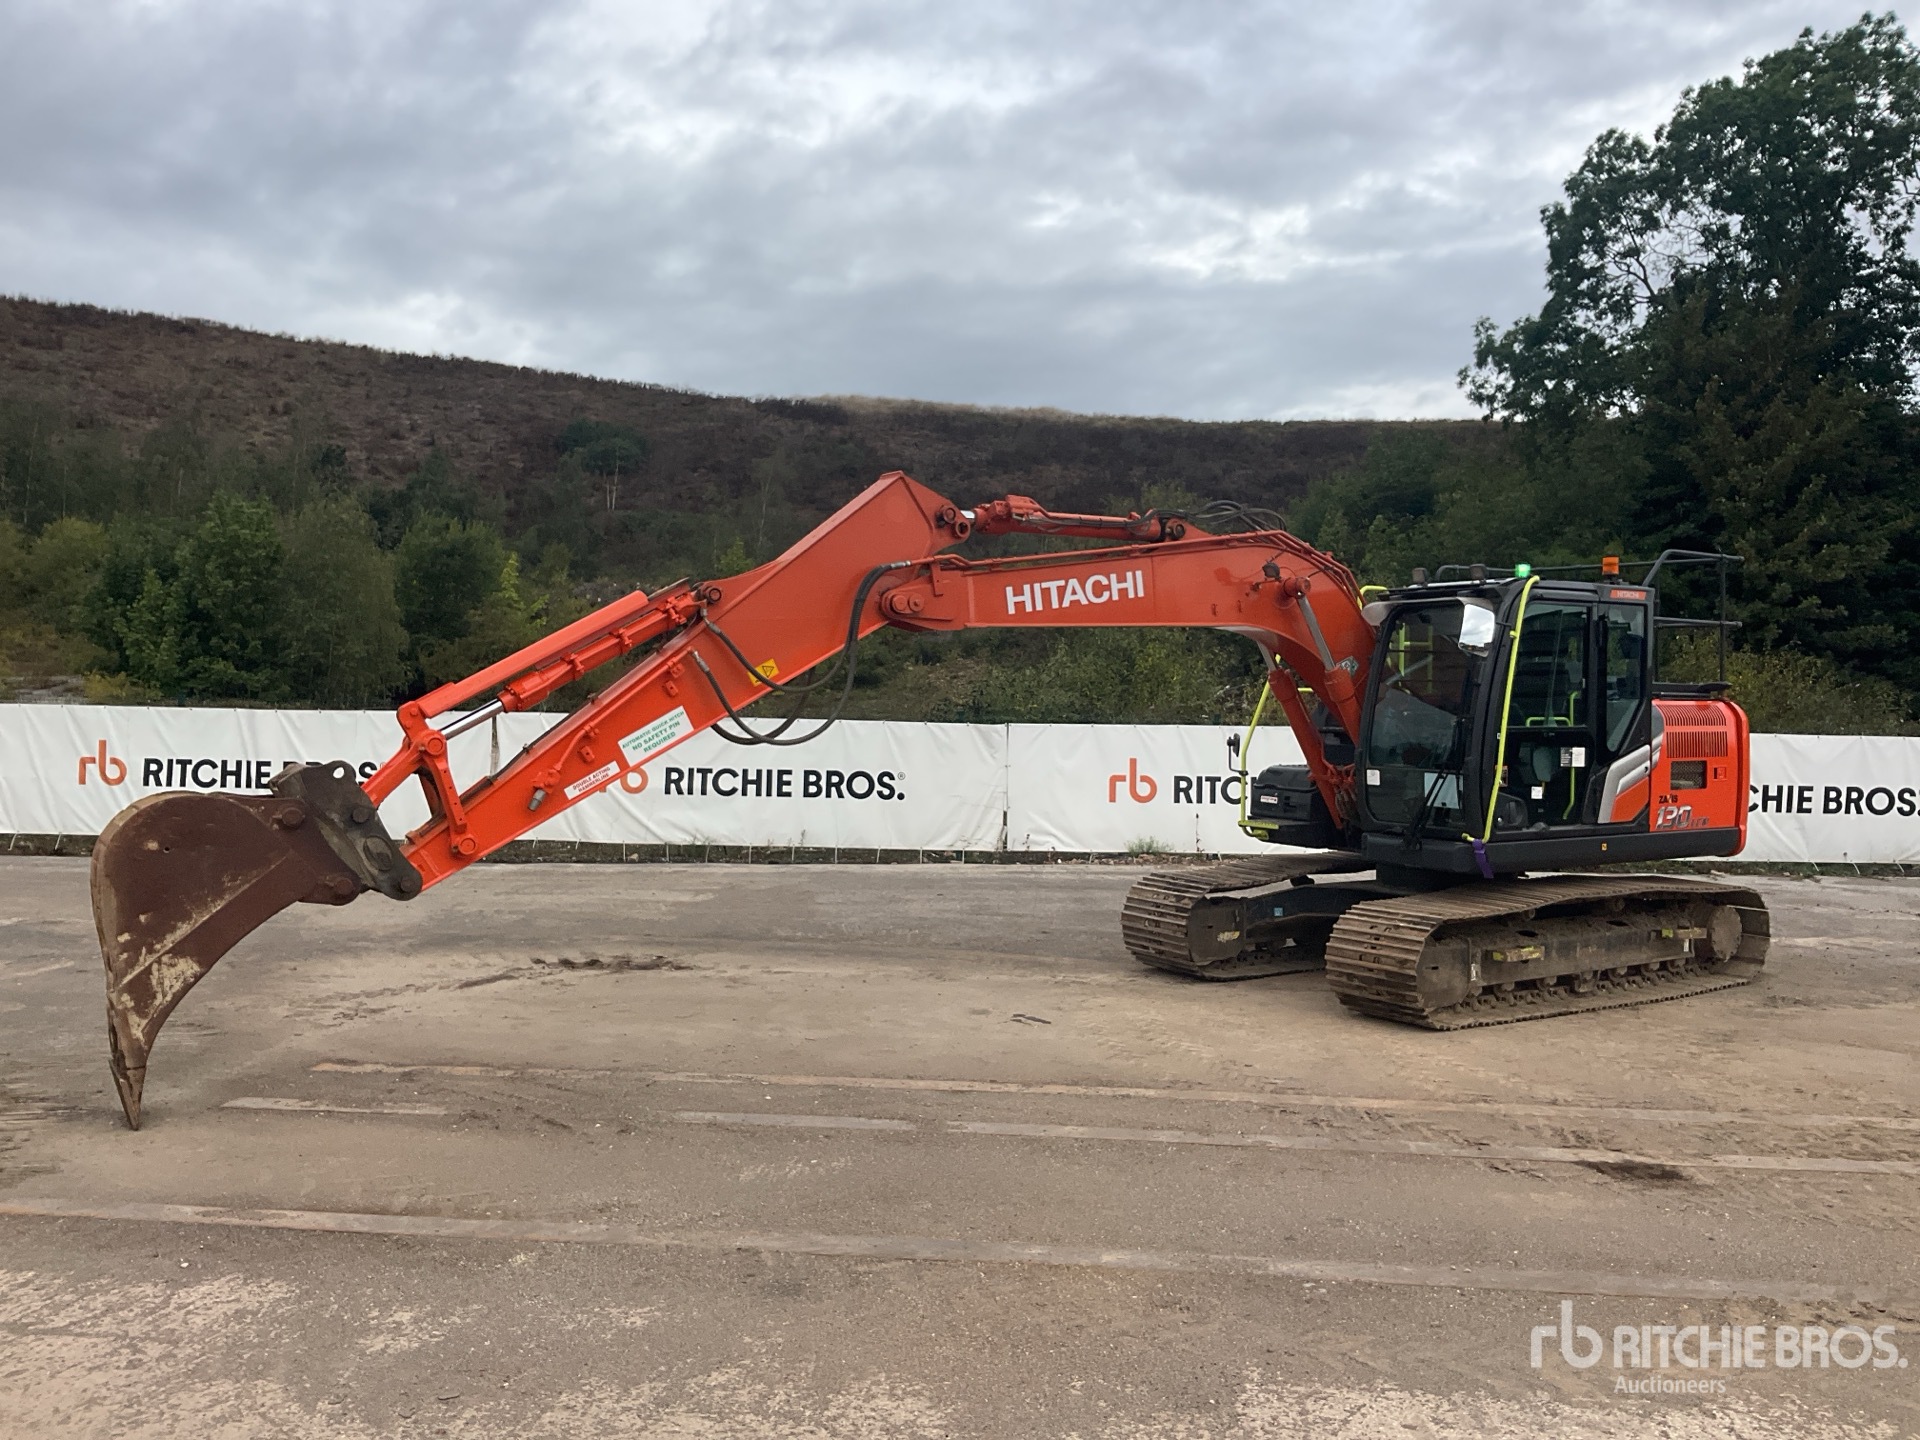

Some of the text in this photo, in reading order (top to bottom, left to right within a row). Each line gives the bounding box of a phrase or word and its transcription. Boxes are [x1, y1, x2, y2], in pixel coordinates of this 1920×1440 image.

[1005, 570, 1145, 615] HITACHI
[622, 710, 685, 749] AUTOMATIC QUICK HITCH
[632, 720, 681, 751] NO SAFETY PIN
[643, 731, 676, 753] REQUIRED
[142, 757, 271, 789] RITCHIE
[664, 767, 793, 797] RITCHIE
